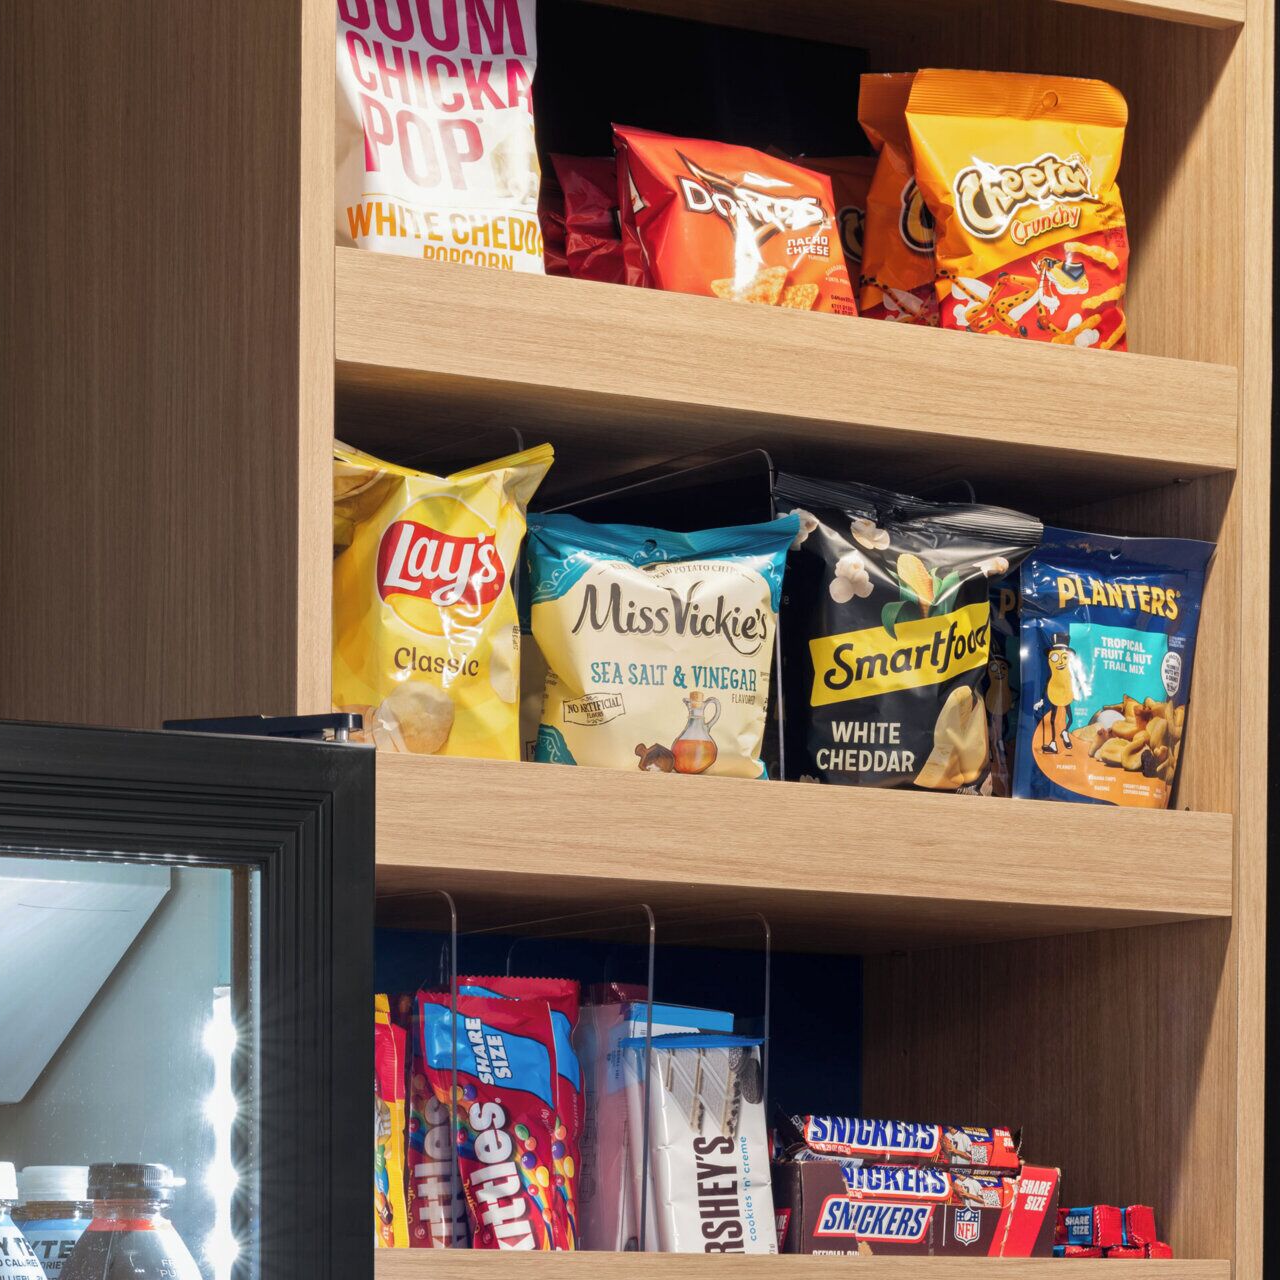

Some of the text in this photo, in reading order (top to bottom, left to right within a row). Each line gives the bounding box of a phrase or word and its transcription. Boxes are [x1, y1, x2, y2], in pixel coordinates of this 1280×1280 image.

[346, 30, 533, 114] CHICKA
[358, 92, 484, 191] POP
[347, 202, 444, 241] WHITE
[1012, 203, 1080, 242] Crunchy
[786, 245, 829, 256] CHEESE
[384, 523, 497, 606] Lay's
[1057, 576, 1178, 620] PLANTERS
[572, 580, 767, 656] Miss Vickie's
[1094, 647, 1152, 664] FRUIT NUT
[1101, 637, 1145, 653] TROPICAL
[394, 647, 480, 676] Classic
[591, 661, 757, 692] SEA SALT & VINEGAR
[1103, 660, 1145, 675] TRAIL MIX
[567, 697, 621, 714] NO ARTIFICIAL
[832, 721, 901, 744] WHITE
[816, 748, 915, 773] CHEDDAR
[465, 1017, 494, 1085] SHARE
[486, 1035, 512, 1079] SIZE
[811, 1115, 938, 1151] SNICKERS
[740, 1136, 757, 1242] cookies creme
[1019, 1179, 1052, 1196] SHARE
[1024, 1195, 1047, 1211] SIZE
[823, 1201, 930, 1237] SNICKERS
[957, 1223, 977, 1239] NFL
[1065, 1215, 1091, 1226] SHARE
[1072, 1225, 1091, 1235] SIZE
